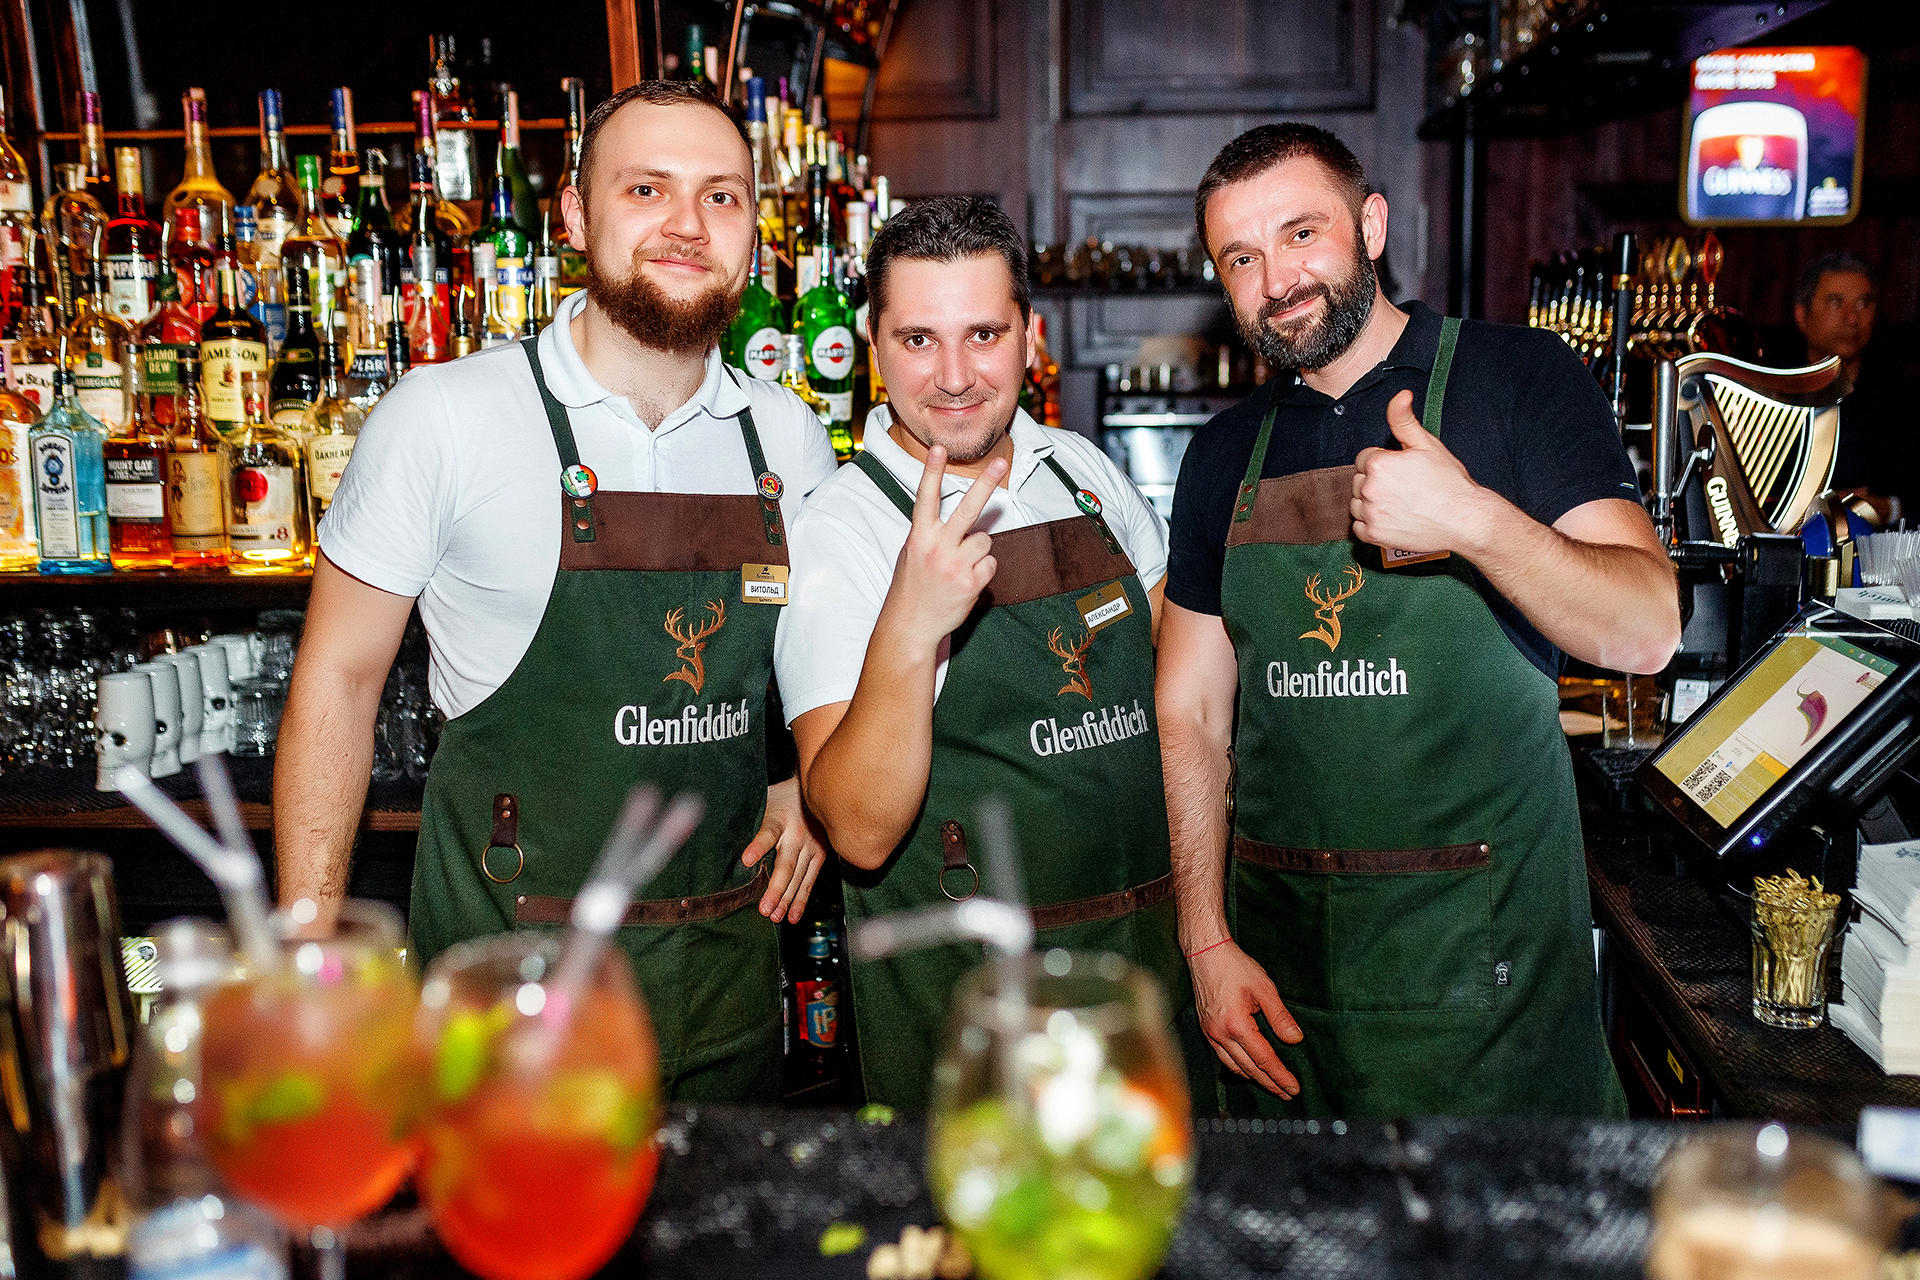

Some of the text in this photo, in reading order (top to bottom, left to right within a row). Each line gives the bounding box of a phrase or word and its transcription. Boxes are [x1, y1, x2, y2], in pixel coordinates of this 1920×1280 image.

[203, 347, 259, 362] JAMESON
[38, 441, 66, 456] BOMBAY
[134, 459, 153, 471] GAY
[750, 585, 779, 595] ВИТОЛЬД
[1087, 602, 1121, 623] АЛЕКСАНДР
[1264, 657, 1409, 698] Glenfiddich
[614, 699, 749, 746] Glenfiddich
[1029, 699, 1149, 757] Glenfiddich
